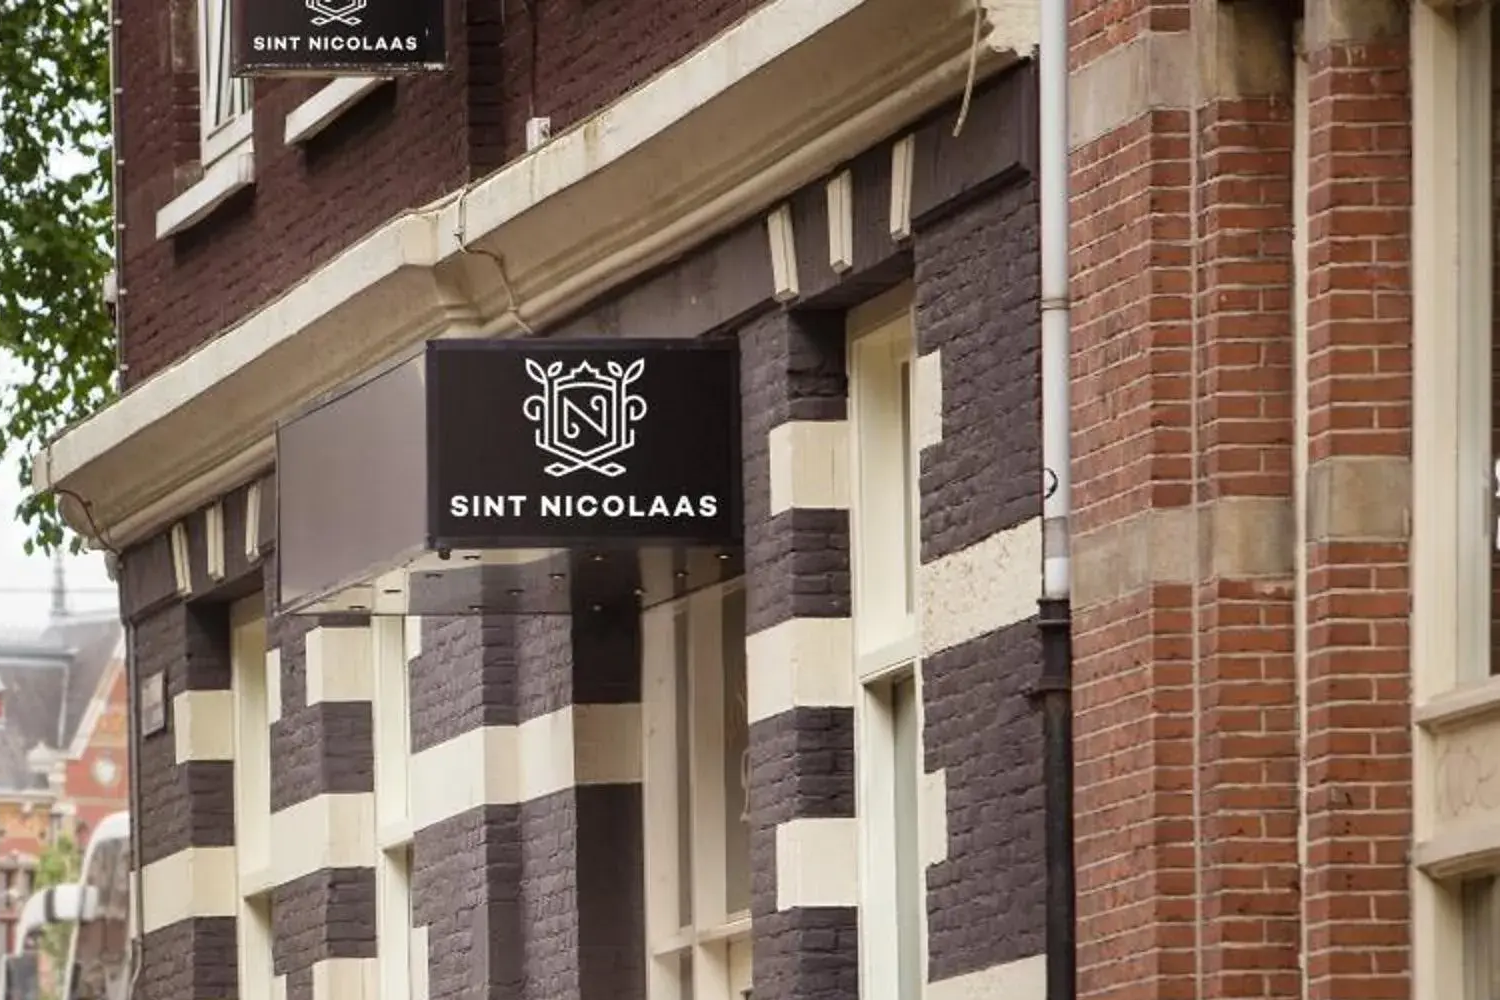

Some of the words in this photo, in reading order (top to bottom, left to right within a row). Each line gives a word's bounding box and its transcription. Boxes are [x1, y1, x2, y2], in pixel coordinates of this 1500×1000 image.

[253, 36, 300, 51] SINT
[309, 36, 418, 51] NICOLAAS
[450, 495, 527, 517] SINT
[540, 495, 718, 517] NICOLAAS
